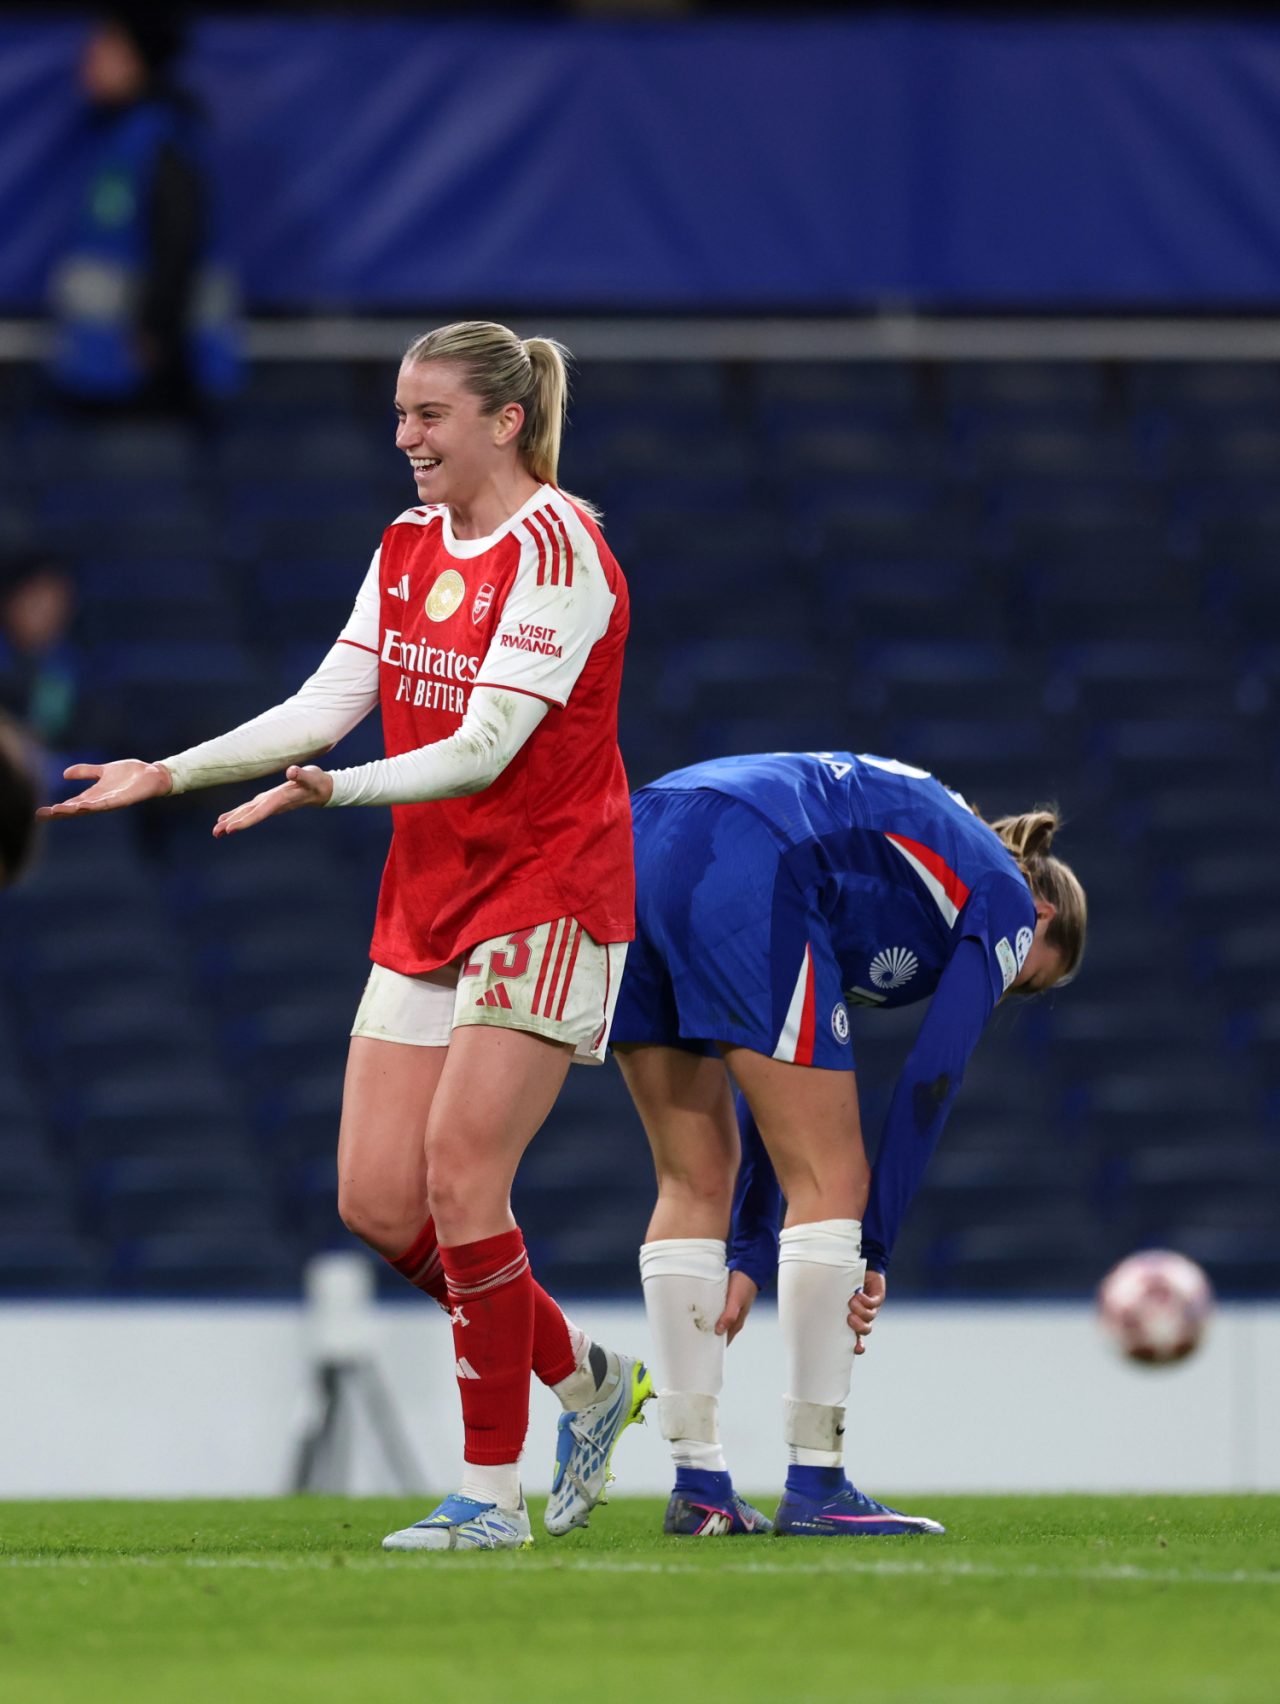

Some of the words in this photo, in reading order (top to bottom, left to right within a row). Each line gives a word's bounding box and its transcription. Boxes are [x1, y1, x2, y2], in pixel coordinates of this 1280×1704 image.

[500, 634, 563, 658] RWANDA
[519, 623, 557, 641] VISIT
[380, 628, 480, 684] Emirates
[413, 679, 464, 714] BETTER
